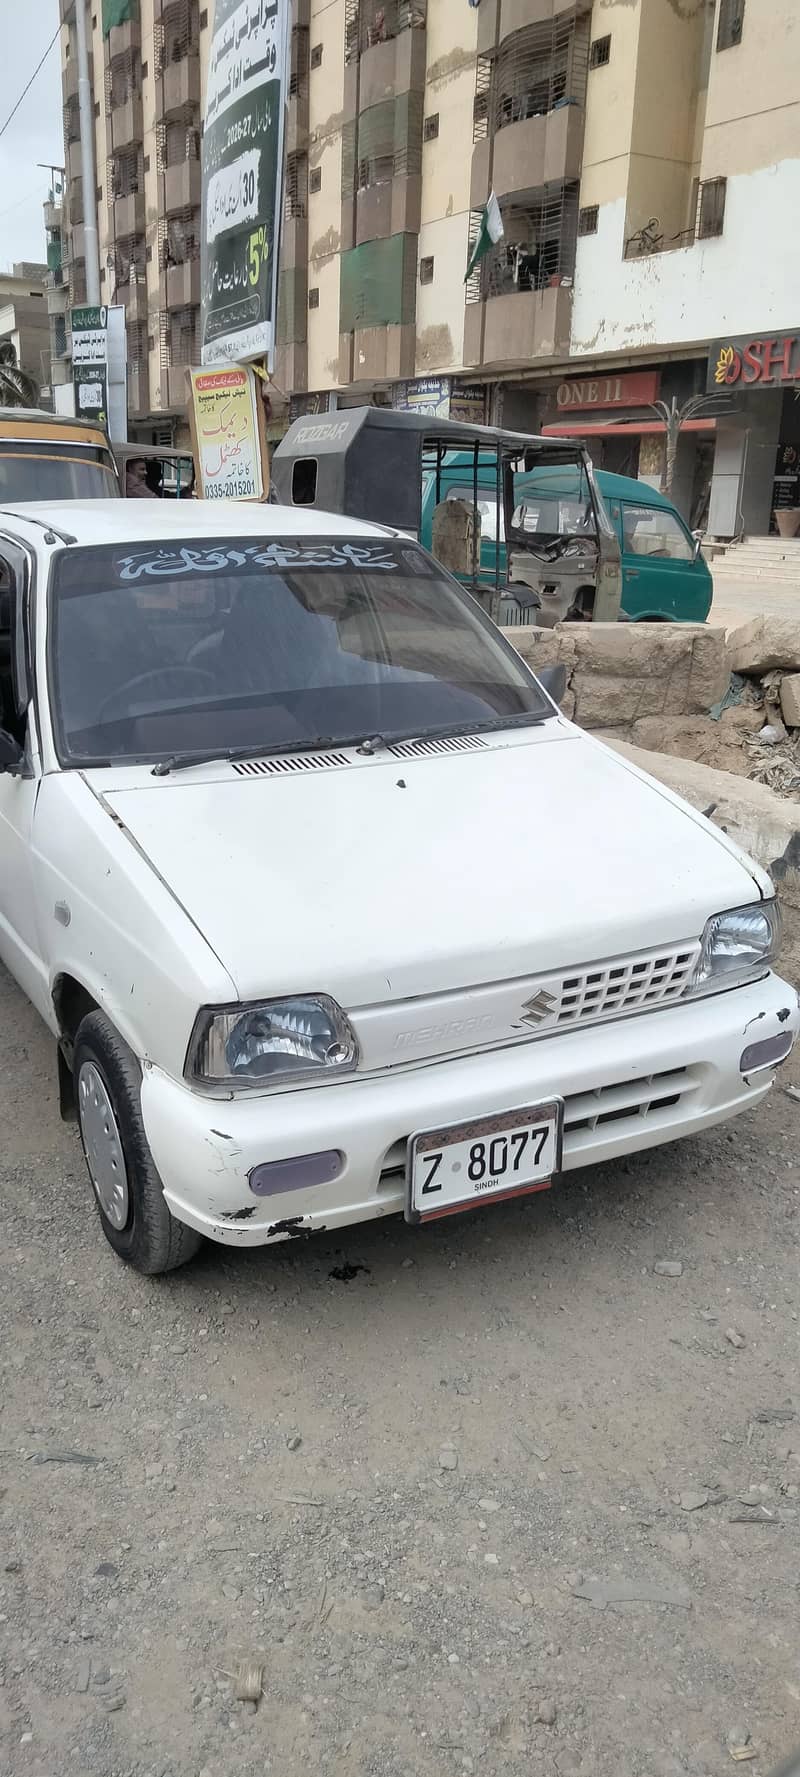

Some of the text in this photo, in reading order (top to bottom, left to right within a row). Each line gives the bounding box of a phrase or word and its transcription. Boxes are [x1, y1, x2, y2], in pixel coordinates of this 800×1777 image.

[243, 40, 276, 81] وقت
[227, 115, 251, 146] 2026-27
[243, 169, 255, 208] 30
[249, 224, 269, 286] 5%
[725, 337, 800, 384] OSH
[557, 382, 599, 406] ONE
[203, 400, 248, 438] دیمک
[205, 436, 248, 477] کھٹمل
[226, 461, 252, 479] کا خاتمہ
[205, 480, 256, 499] 0335-2015201
[422, 1126, 550, 1194] Z 8077
[474, 1179, 499, 1191] SINDH
